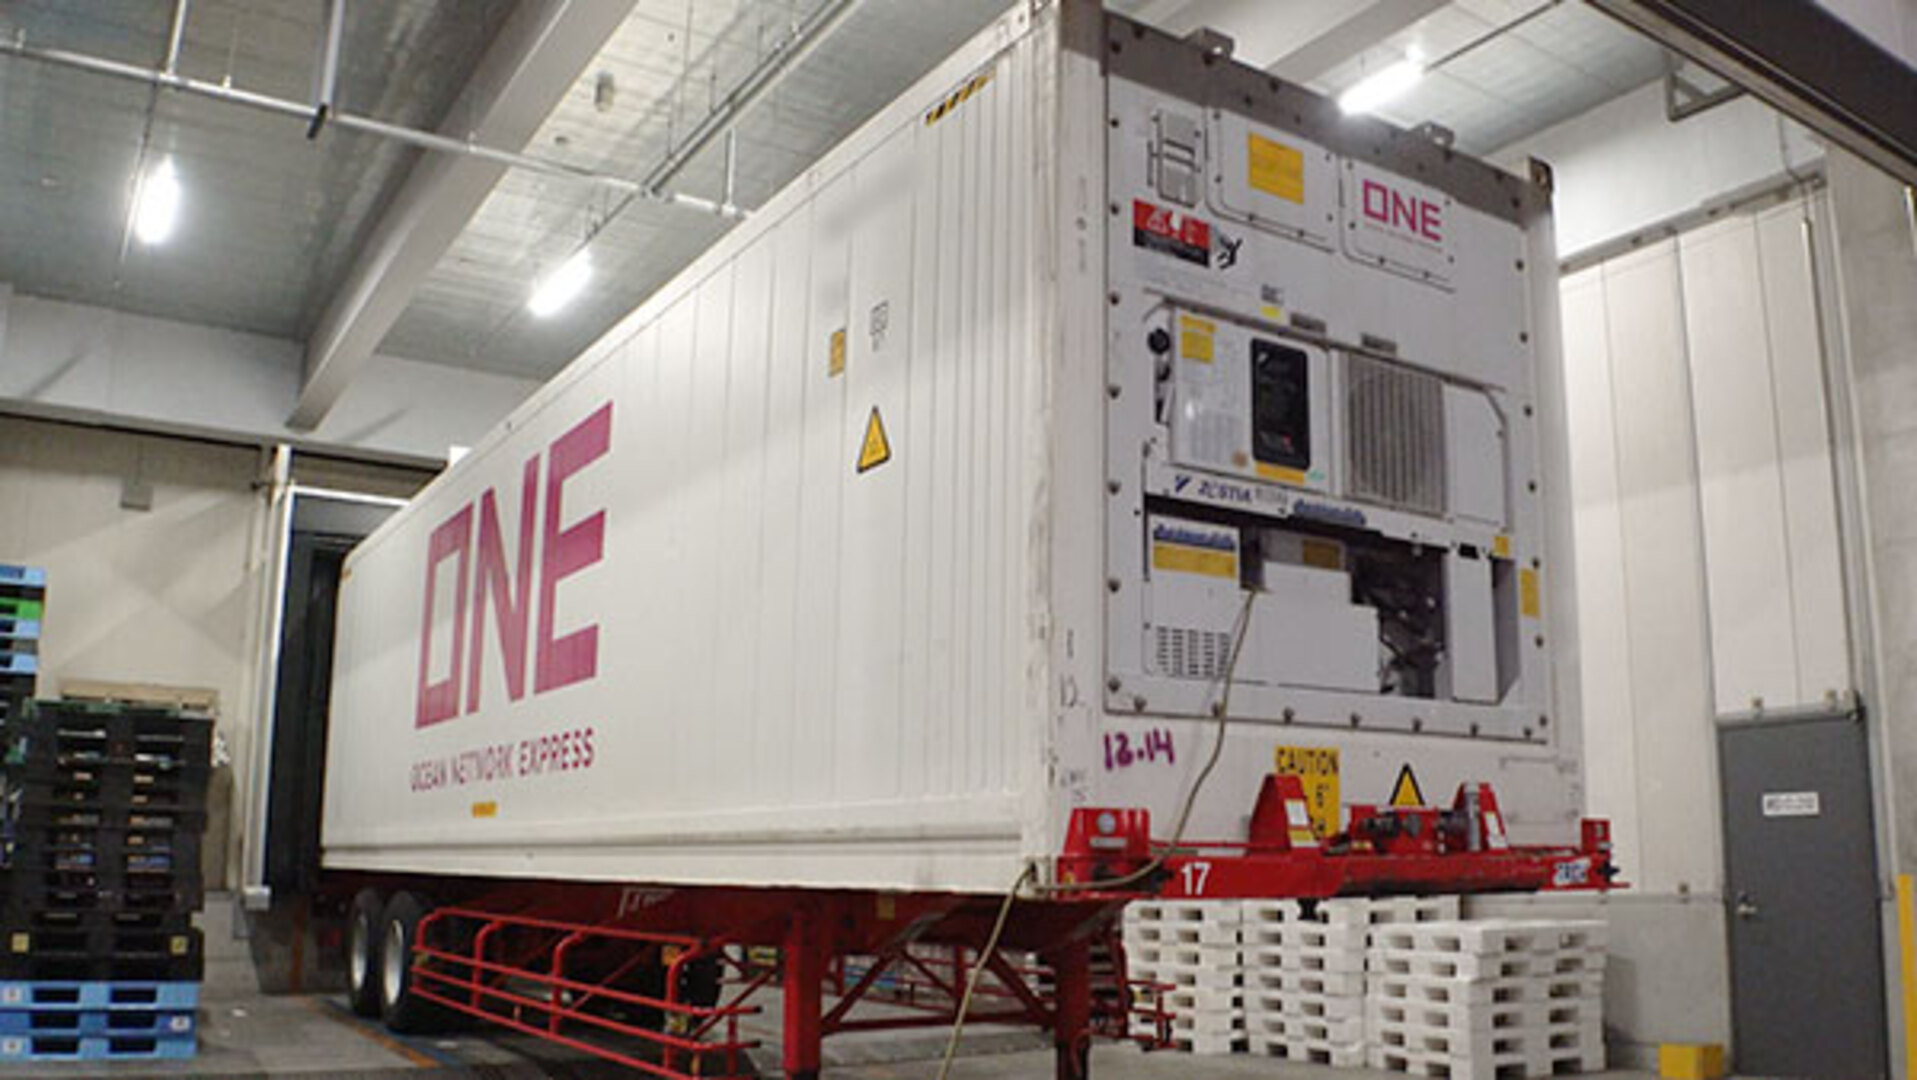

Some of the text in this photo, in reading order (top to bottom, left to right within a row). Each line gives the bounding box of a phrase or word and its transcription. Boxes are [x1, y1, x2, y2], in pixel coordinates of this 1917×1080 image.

[1363, 179, 1442, 242] ONE
[415, 401, 613, 730] ONE
[411, 727, 594, 792] OCEAN NETWORK EXPRESS
[1277, 747, 1339, 776] CAUTION
[1181, 861, 1212, 896] 17
